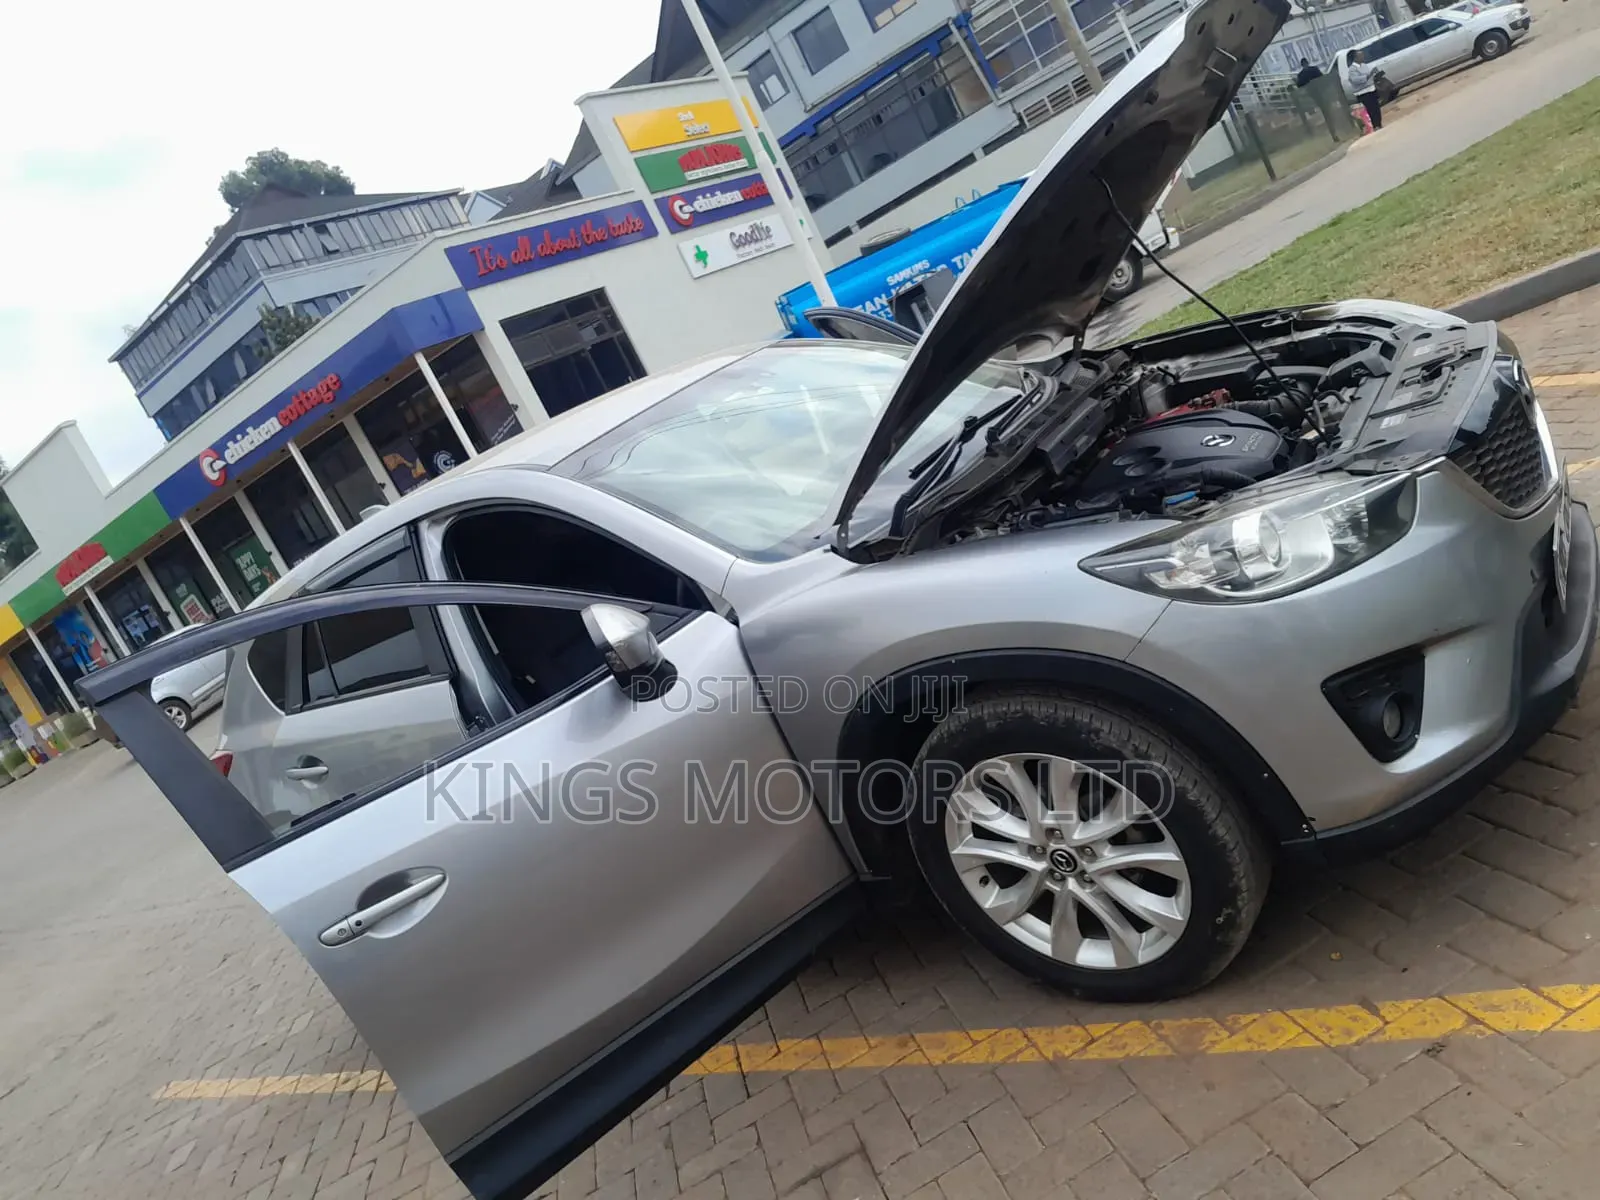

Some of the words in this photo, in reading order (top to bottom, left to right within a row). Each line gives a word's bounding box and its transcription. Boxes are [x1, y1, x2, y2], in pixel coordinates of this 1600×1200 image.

[693, 190, 744, 213] chicken
[469, 243, 508, 277] It's
[511, 236, 535, 264] all
[537, 229, 582, 256] about
[580, 220, 609, 245] the
[607, 213, 645, 238] taste
[224, 416, 283, 465] chicken
[277, 373, 342, 427] cottage
